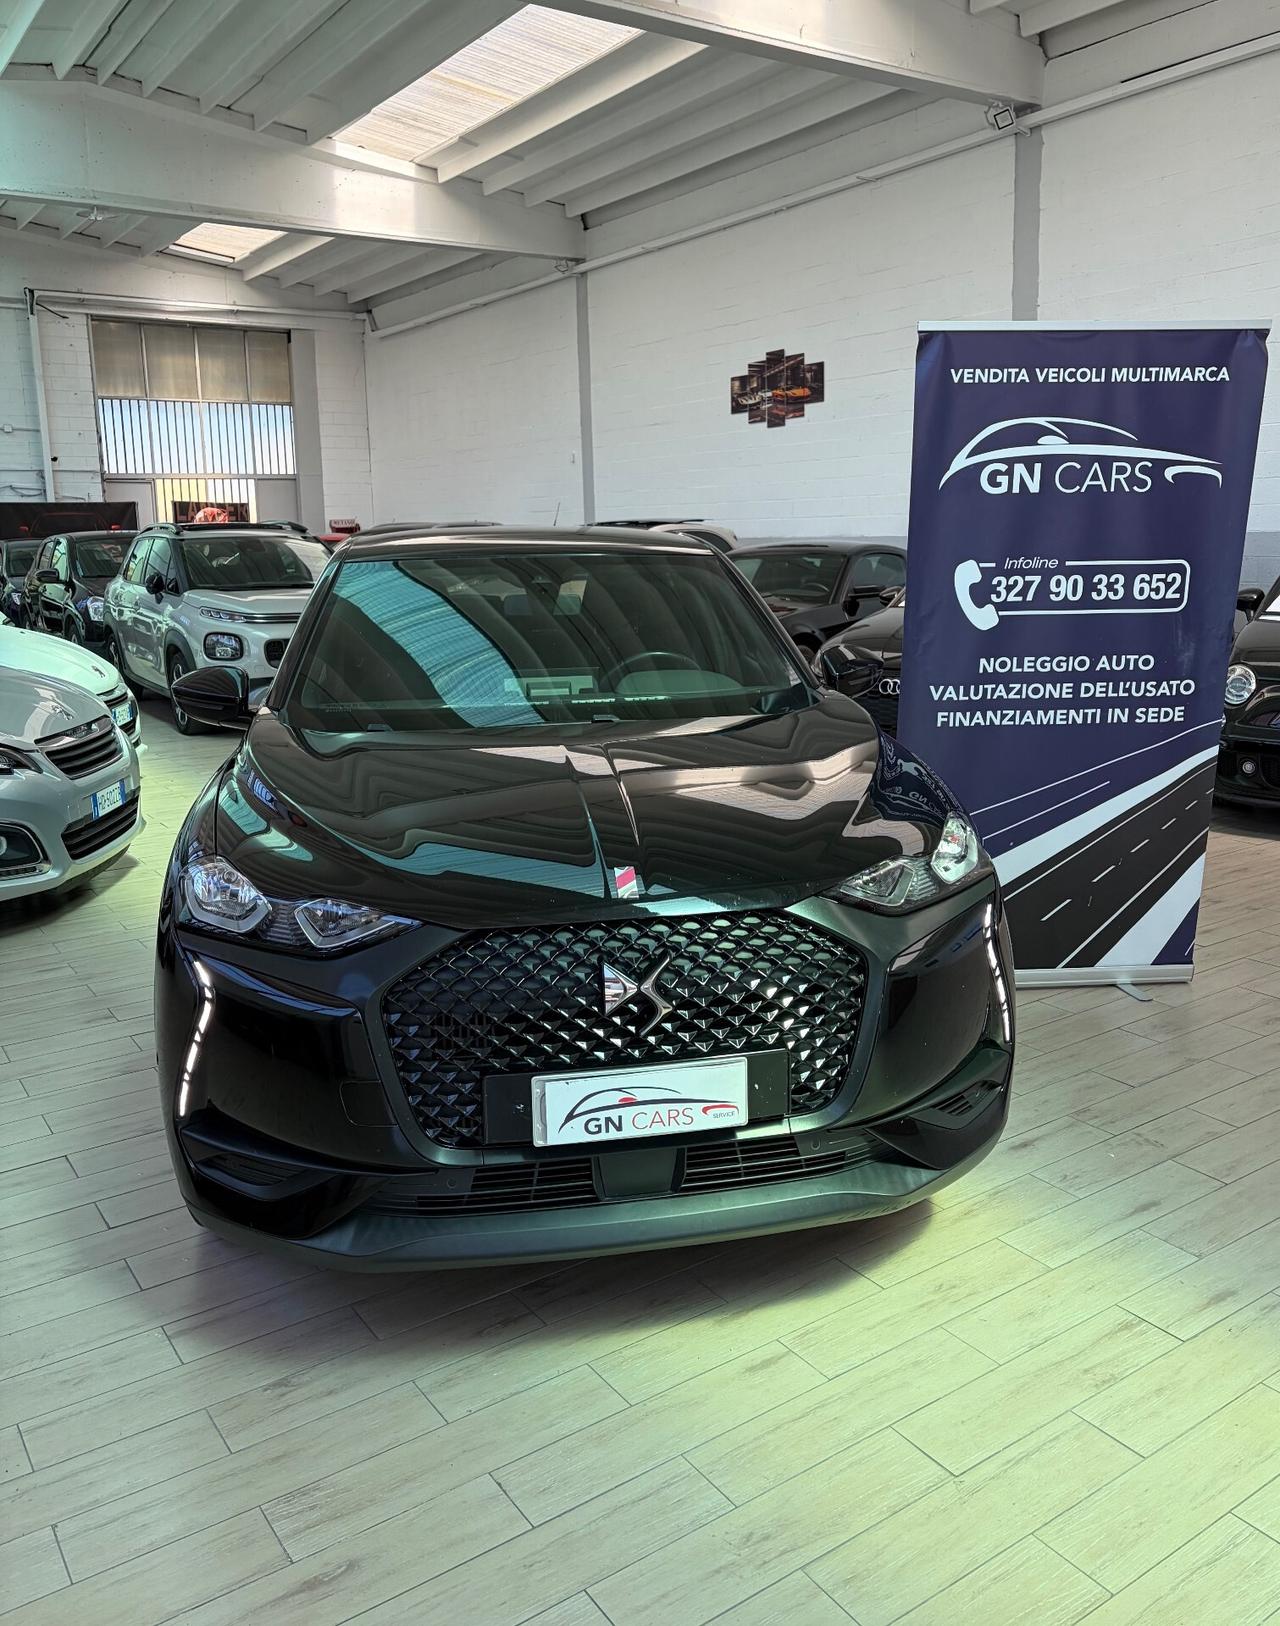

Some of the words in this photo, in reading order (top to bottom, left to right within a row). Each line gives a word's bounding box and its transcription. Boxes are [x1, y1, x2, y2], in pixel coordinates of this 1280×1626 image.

[950, 368, 1030, 384] VENDITA
[1035, 367, 1106, 383] VEICOLI
[1111, 366, 1230, 383] MULTIMARCA
[979, 462, 1042, 495] GN
[1054, 461, 1153, 494] CARS
[1004, 556, 1059, 570] Infoline
[990, 575, 1042, 603] 327
[1049, 574, 1084, 602] 90
[1091, 573, 1125, 601] 33
[1132, 572, 1182, 600] 652
[978, 655, 1090, 674] NOLEGGIO
[1095, 654, 1155, 671] AUTO
[929, 683, 1074, 701] VALUTAZIONE
[936, 709, 1101, 727] FINANZIAMENTI
[1107, 708, 1129, 724] IN
[1134, 706, 1185, 723] SEDE
[584, 1114, 624, 1136] GN
[631, 1106, 695, 1131] CARS
[712, 1110, 735, 1118] SERVICE
